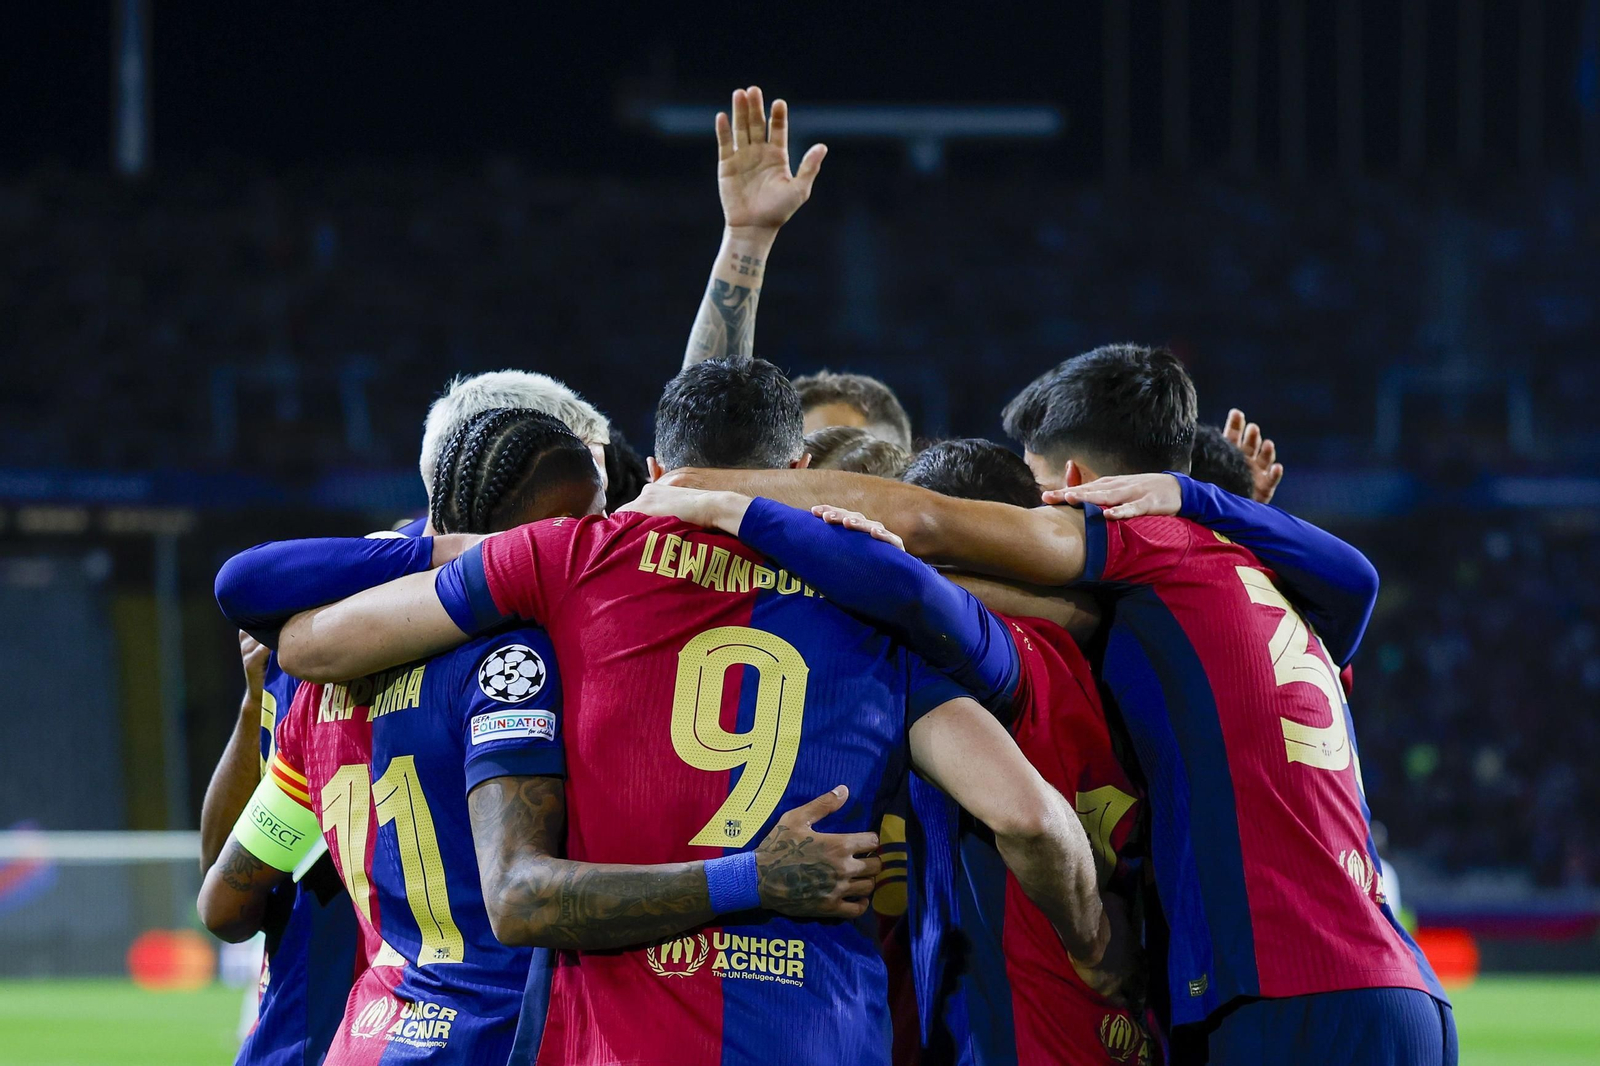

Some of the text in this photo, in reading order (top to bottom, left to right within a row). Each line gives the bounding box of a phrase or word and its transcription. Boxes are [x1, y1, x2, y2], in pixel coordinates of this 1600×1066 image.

[504, 661, 520, 684] 5
[473, 715, 490, 725] UEFA
[671, 626, 810, 849] 9
[321, 755, 464, 968] 11
[713, 932, 805, 959] UNHCR
[711, 951, 804, 979] ACNUR
[712, 970, 804, 987] The UN Refugee Agency
